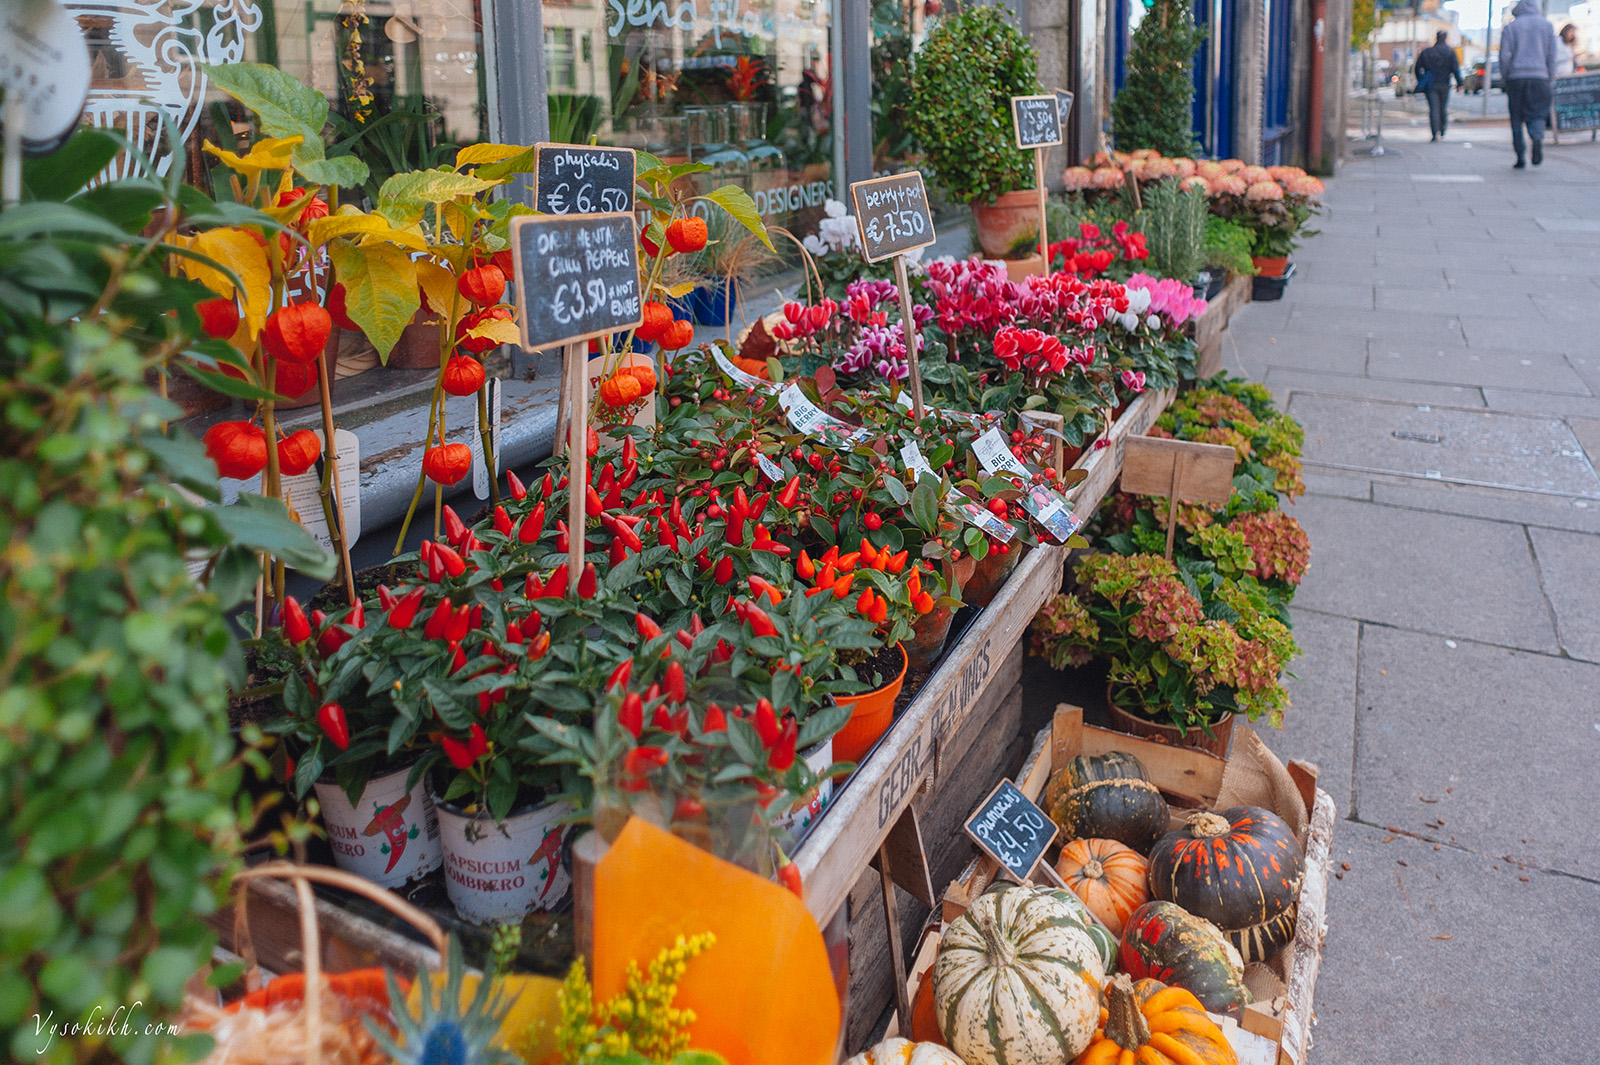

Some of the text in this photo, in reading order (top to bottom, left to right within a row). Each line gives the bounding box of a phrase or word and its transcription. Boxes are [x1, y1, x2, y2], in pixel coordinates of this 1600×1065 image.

[553, 149, 619, 180] physalis
[754, 180, 834, 217] DESIGNERS
[866, 210, 924, 244] €7.50
[585, 248, 631, 272] PEPPERS
[551, 278, 606, 324] €3.50
[794, 405, 808, 418] BIG
[795, 407, 818, 428] BERRY
[991, 453, 1006, 468] BIG
[996, 811, 1044, 868] €4.50
